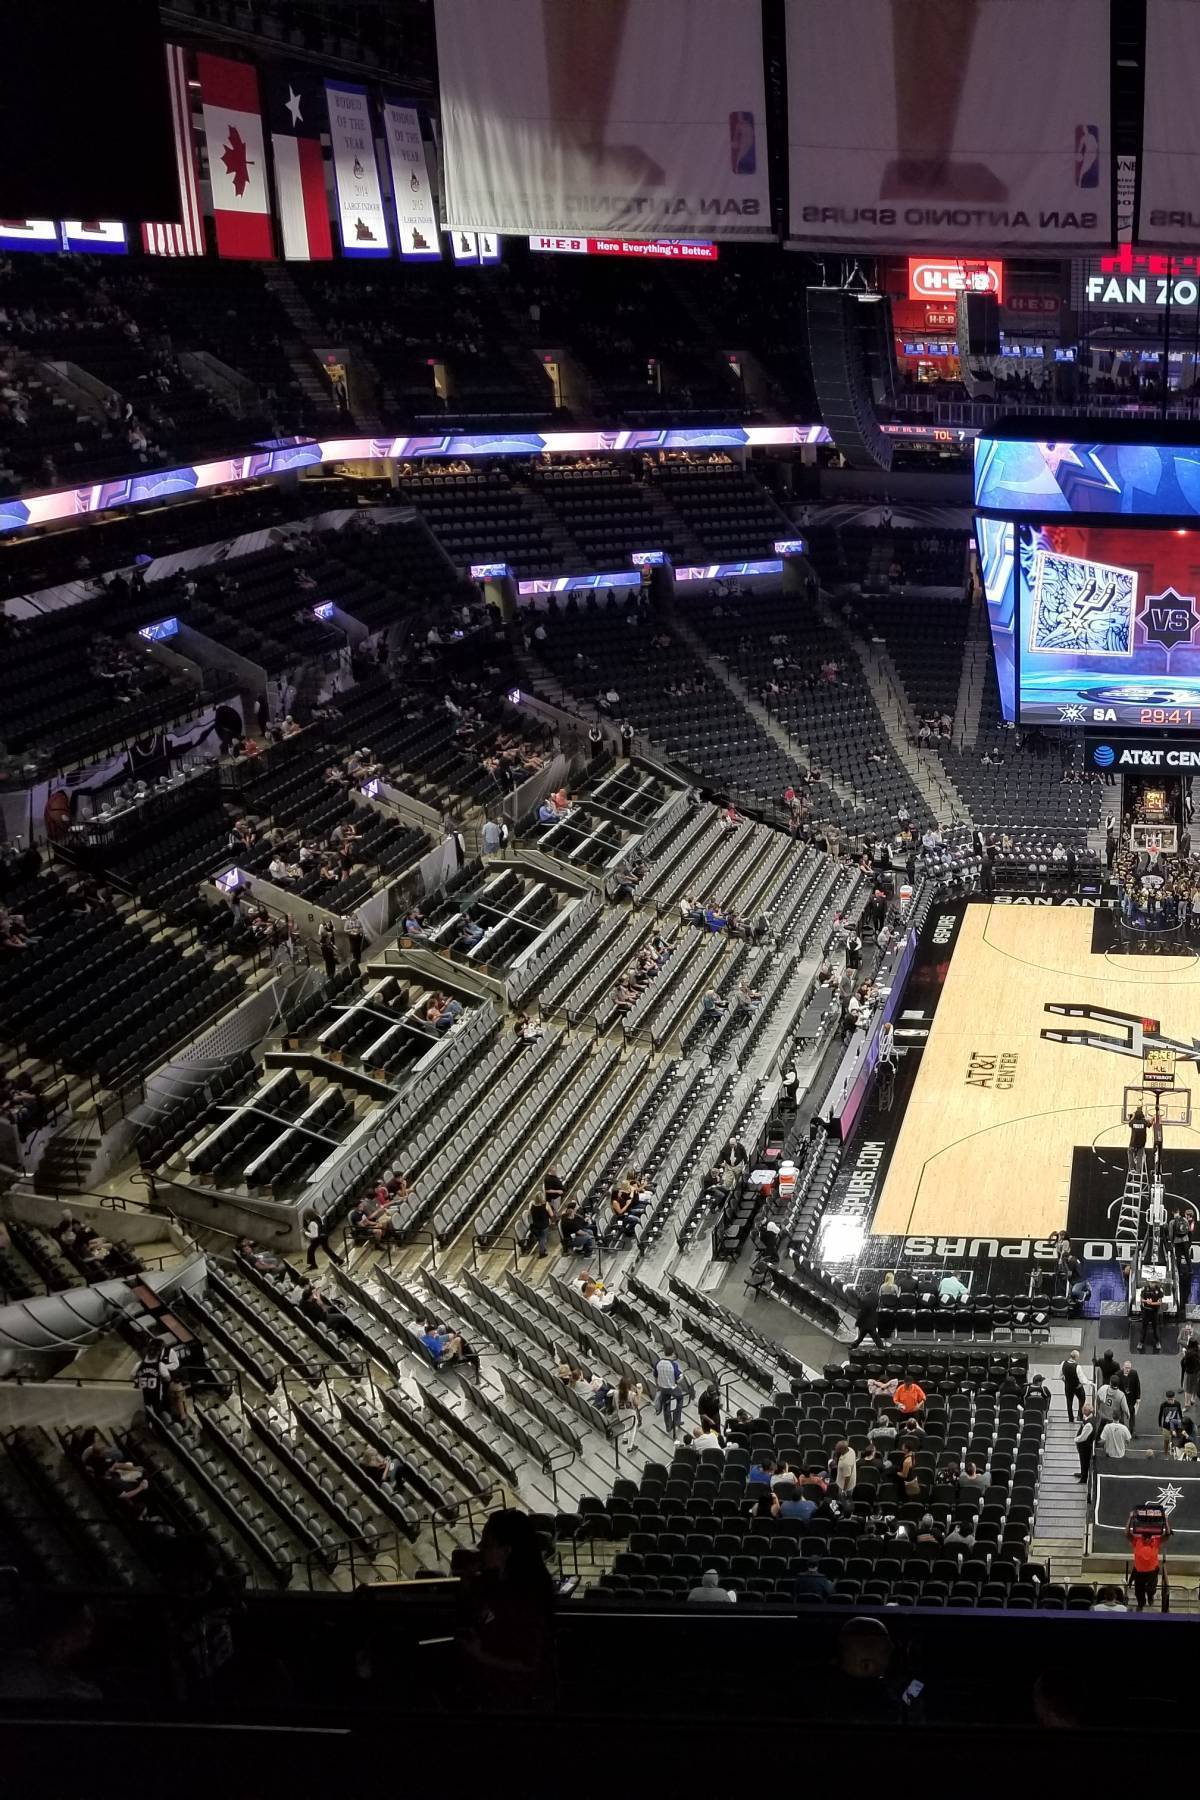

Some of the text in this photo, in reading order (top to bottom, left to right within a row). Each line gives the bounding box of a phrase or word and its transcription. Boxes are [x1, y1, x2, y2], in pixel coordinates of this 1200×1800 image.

[337, 116, 365, 130] OF THE
[344, 136, 365, 150] YEAR
[395, 130, 419, 144] OF THE
[402, 150, 418, 161] YEAR
[596, 242, 619, 252] Here
[622, 243, 680, 257] Everything's
[1085, 276, 1146, 304] FAN
[933, 430, 966, 441] TOL 7
[1151, 608, 1189, 632] VS
[1093, 708, 1117, 722] SA
[1140, 709, 1192, 724] 29:41
[1119, 749, 1164, 765] AT&T
[1149, 799, 1162, 808] 24
[994, 895, 1053, 906] SAN
[932, 915, 956, 944] @SPURS
[965, 1051, 998, 1089] AT&T
[995, 1052, 1020, 1090] CENTER
[840, 1141, 886, 1216] SPURS.COM
[903, 1237, 1062, 1260] SPURS
